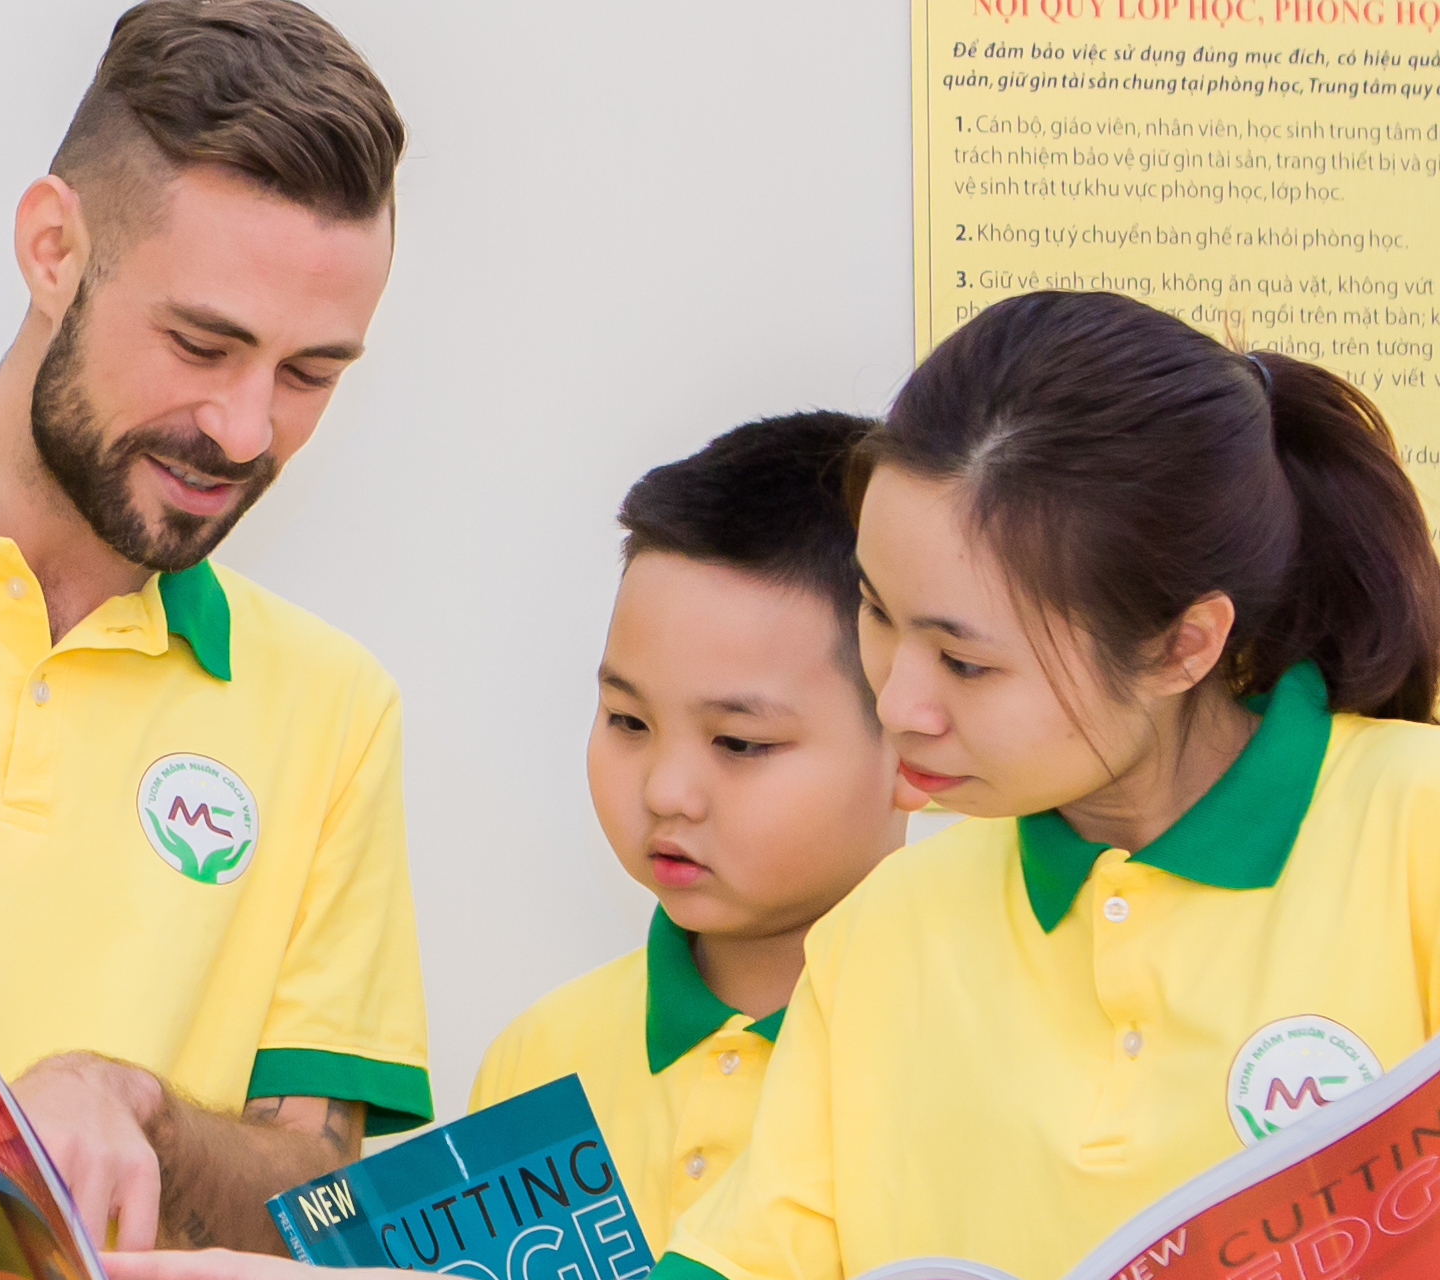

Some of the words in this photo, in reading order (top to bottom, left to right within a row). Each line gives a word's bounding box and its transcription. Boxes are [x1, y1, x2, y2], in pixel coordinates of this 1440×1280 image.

[953, 38, 980, 58] Để
[984, 41, 1024, 59] đảm
[1031, 42, 1065, 60] bảo
[1072, 43, 1107, 65] việc
[1113, 44, 1136, 61] sử
[1140, 45, 1186, 66] dụng
[1193, 46, 1238, 67] đúng
[1245, 50, 1282, 68] mục
[1288, 47, 1331, 66] đích,
[1337, 49, 1357, 66] có
[1363, 49, 1401, 71] hiệu
[942, 70, 994, 90] quản,
[997, 71, 1028, 92] giữ
[1030, 72, 1061, 92] gìn
[1061, 72, 1086, 89] tài
[1088, 71, 1119, 90] sản
[1122, 73, 1177, 95] chung
[1181, 75, 1205, 96] tại
[1207, 75, 1264, 96] phòng
[1268, 75, 1304, 97] học,
[1309, 77, 1359, 98] Trung
[1362, 78, 1397, 96] tâm
[1400, 82, 1433, 101] quy
[954, 115, 971, 133] 1.
[975, 115, 1012, 134] Cán
[1017, 116, 1046, 138] bộ,
[1050, 117, 1092, 139] giáo
[1096, 117, 1141, 138] viên,
[1145, 117, 1194, 137] nhân
[1198, 119, 1242, 140] viên,
[1247, 119, 1281, 142] học
[1287, 120, 1325, 139] sinh
[1329, 123, 1381, 145] trung
[1386, 122, 1422, 141] tâm
[954, 145, 1002, 164] trách
[1007, 147, 1068, 169] nhiệm
[1073, 146, 1109, 166] bảo
[1113, 148, 1135, 170] vệ
[1139, 148, 1170, 171] giữ
[1173, 149, 1203, 171] gìn
[1208, 149, 1230, 169] tài
[1235, 149, 1272, 171] sản,
[1276, 153, 1326, 174] trang
[1331, 151, 1373, 170] thiết
[1400, 154, 1421, 171] và
[954, 176, 976, 198] vệ
[980, 177, 1019, 195] sinh
[1024, 179, 1056, 200] trật
[1061, 179, 1082, 201] tự
[1084, 178, 1120, 196] khu
[1124, 182, 1158, 202] vực
[1161, 179, 1224, 203] phòng
[1228, 180, 1268, 203] học,
[1271, 181, 1302, 205] lớp
[1305, 181, 1345, 205] học.
[955, 224, 973, 242] 2.
[977, 223, 1040, 248] Không
[1045, 226, 1066, 248] tự
[1082, 221, 1152, 248] chuyển
[1156, 225, 1192, 245] bàn
[1196, 225, 1232, 250] ghế
[1236, 231, 1253, 246] ra
[1258, 226, 1298, 246] khỏi
[1303, 228, 1365, 252] phòng
[1369, 228, 1409, 253] học.
[955, 271, 974, 288] 3.
[979, 270, 1014, 289] Giữ
[1046, 272, 1084, 289] sinh
[1090, 272, 1156, 295] chung,
[1162, 273, 1223, 297] không
[1229, 274, 1252, 293] ăn
[1258, 274, 1293, 297] quà
[1299, 276, 1332, 299] vặt,
[1338, 275, 1398, 299] không
[1405, 275, 1433, 295] vứt
[1300, 306, 1337, 325] trên
[1343, 307, 1378, 328] mặt
[1332, 337, 1369, 355] trên
[1377, 338, 1433, 360] tường
[1391, 366, 1425, 388] viết
[297, 1178, 357, 1232] NEW
[380, 1140, 614, 1270] CUTTING
